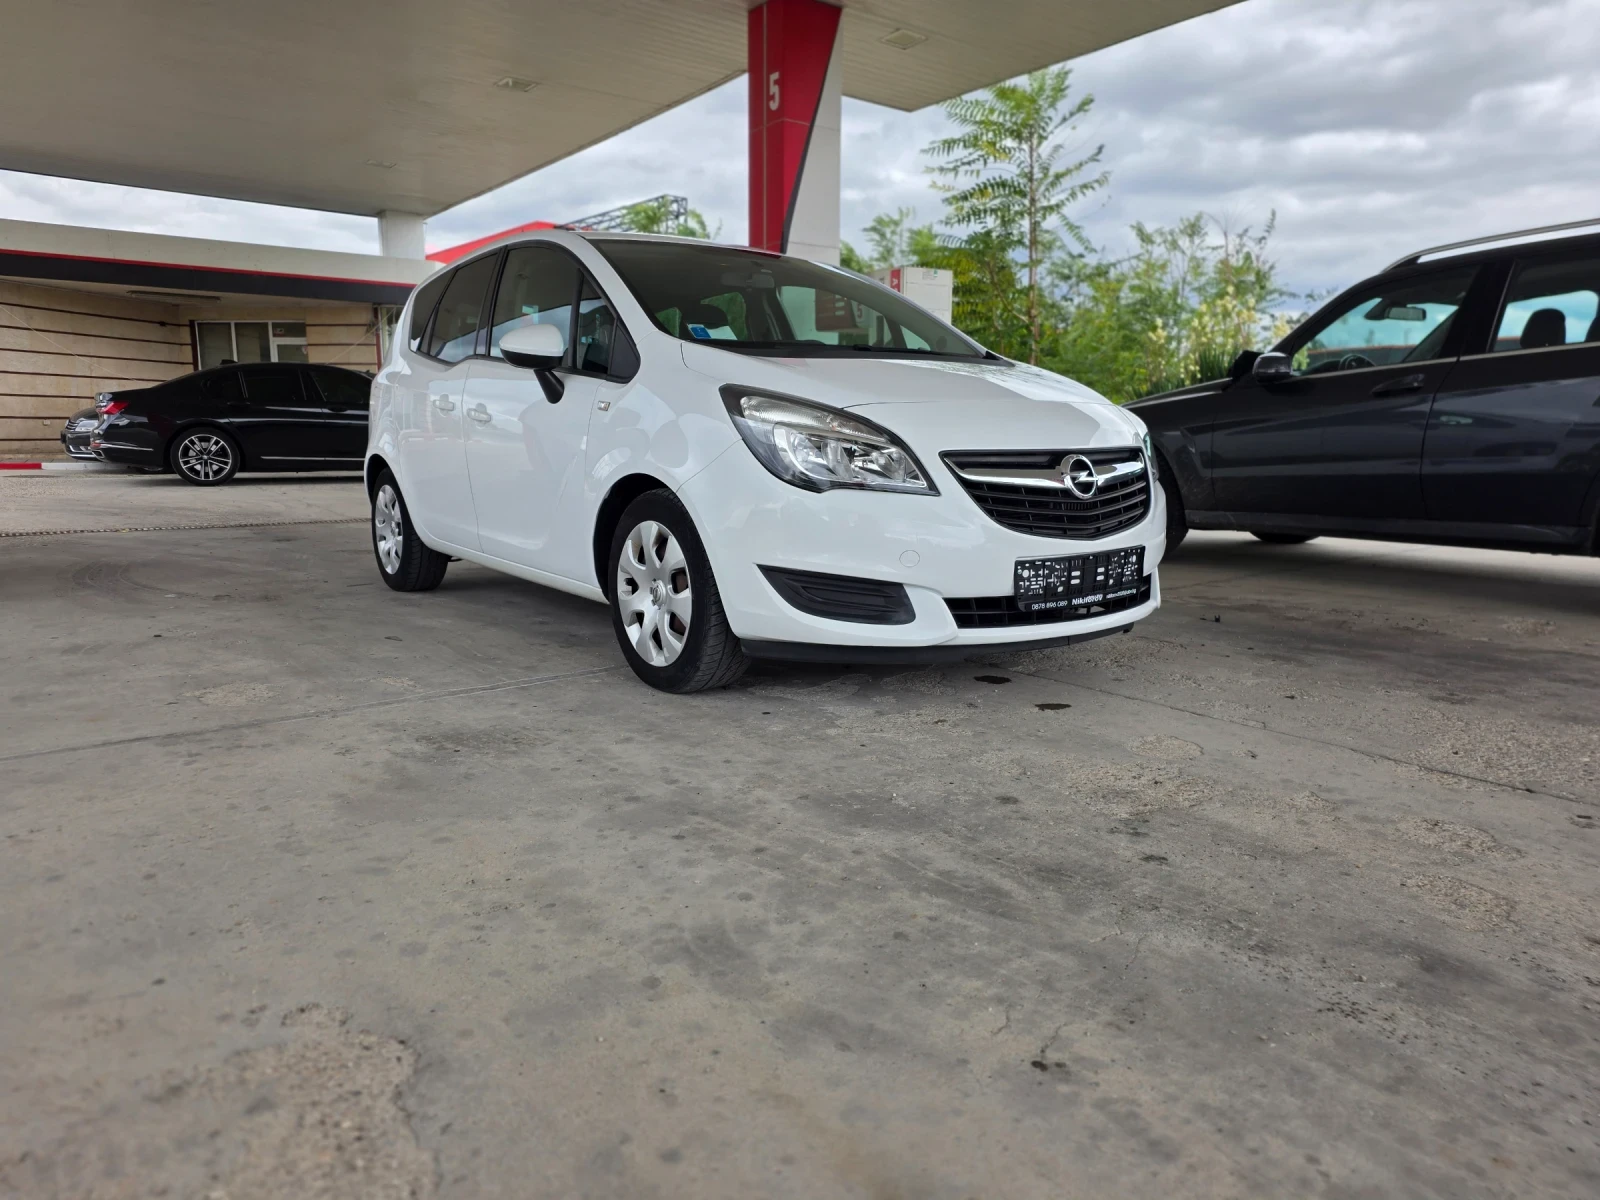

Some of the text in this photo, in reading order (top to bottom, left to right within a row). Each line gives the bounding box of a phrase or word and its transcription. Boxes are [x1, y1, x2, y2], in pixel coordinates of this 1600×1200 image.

[769, 71, 780, 111] 5
[1031, 602, 1045, 610] 0878
[1046, 601, 1057, 609] 896
